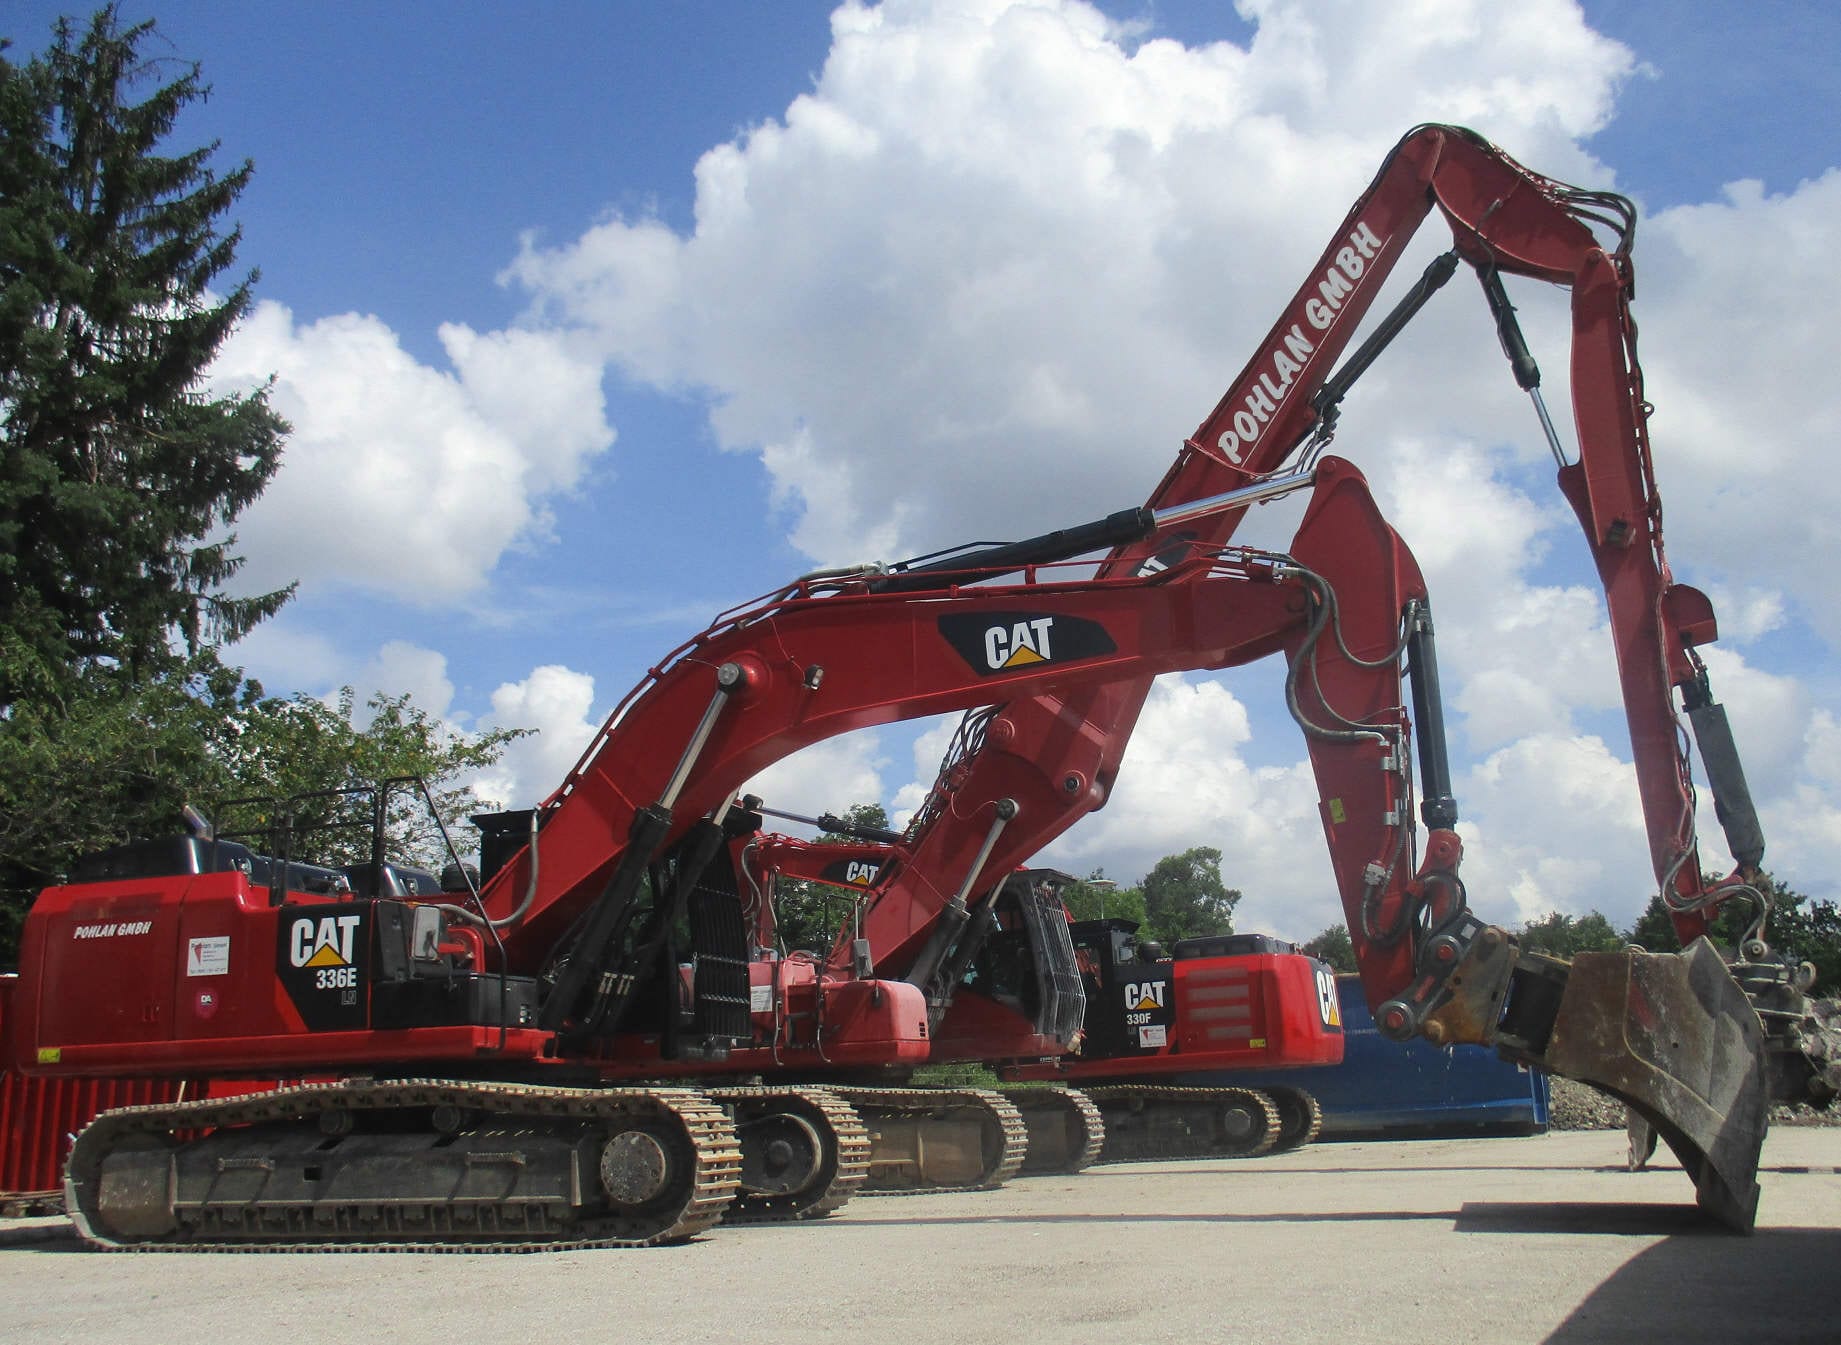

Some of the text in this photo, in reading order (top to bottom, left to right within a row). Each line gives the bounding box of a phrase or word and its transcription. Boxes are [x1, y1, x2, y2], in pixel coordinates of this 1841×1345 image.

[1217, 221, 1382, 464] POHLAN GMBH
[985, 617, 1053, 669] CAT
[846, 861, 879, 884] CAT
[73, 921, 152, 939] POHLAN GMBH
[290, 915, 360, 968] CAT
[316, 967, 357, 989] 336E
[1124, 981, 1166, 1010] CAT
[1126, 1012, 1152, 1025] 330F
